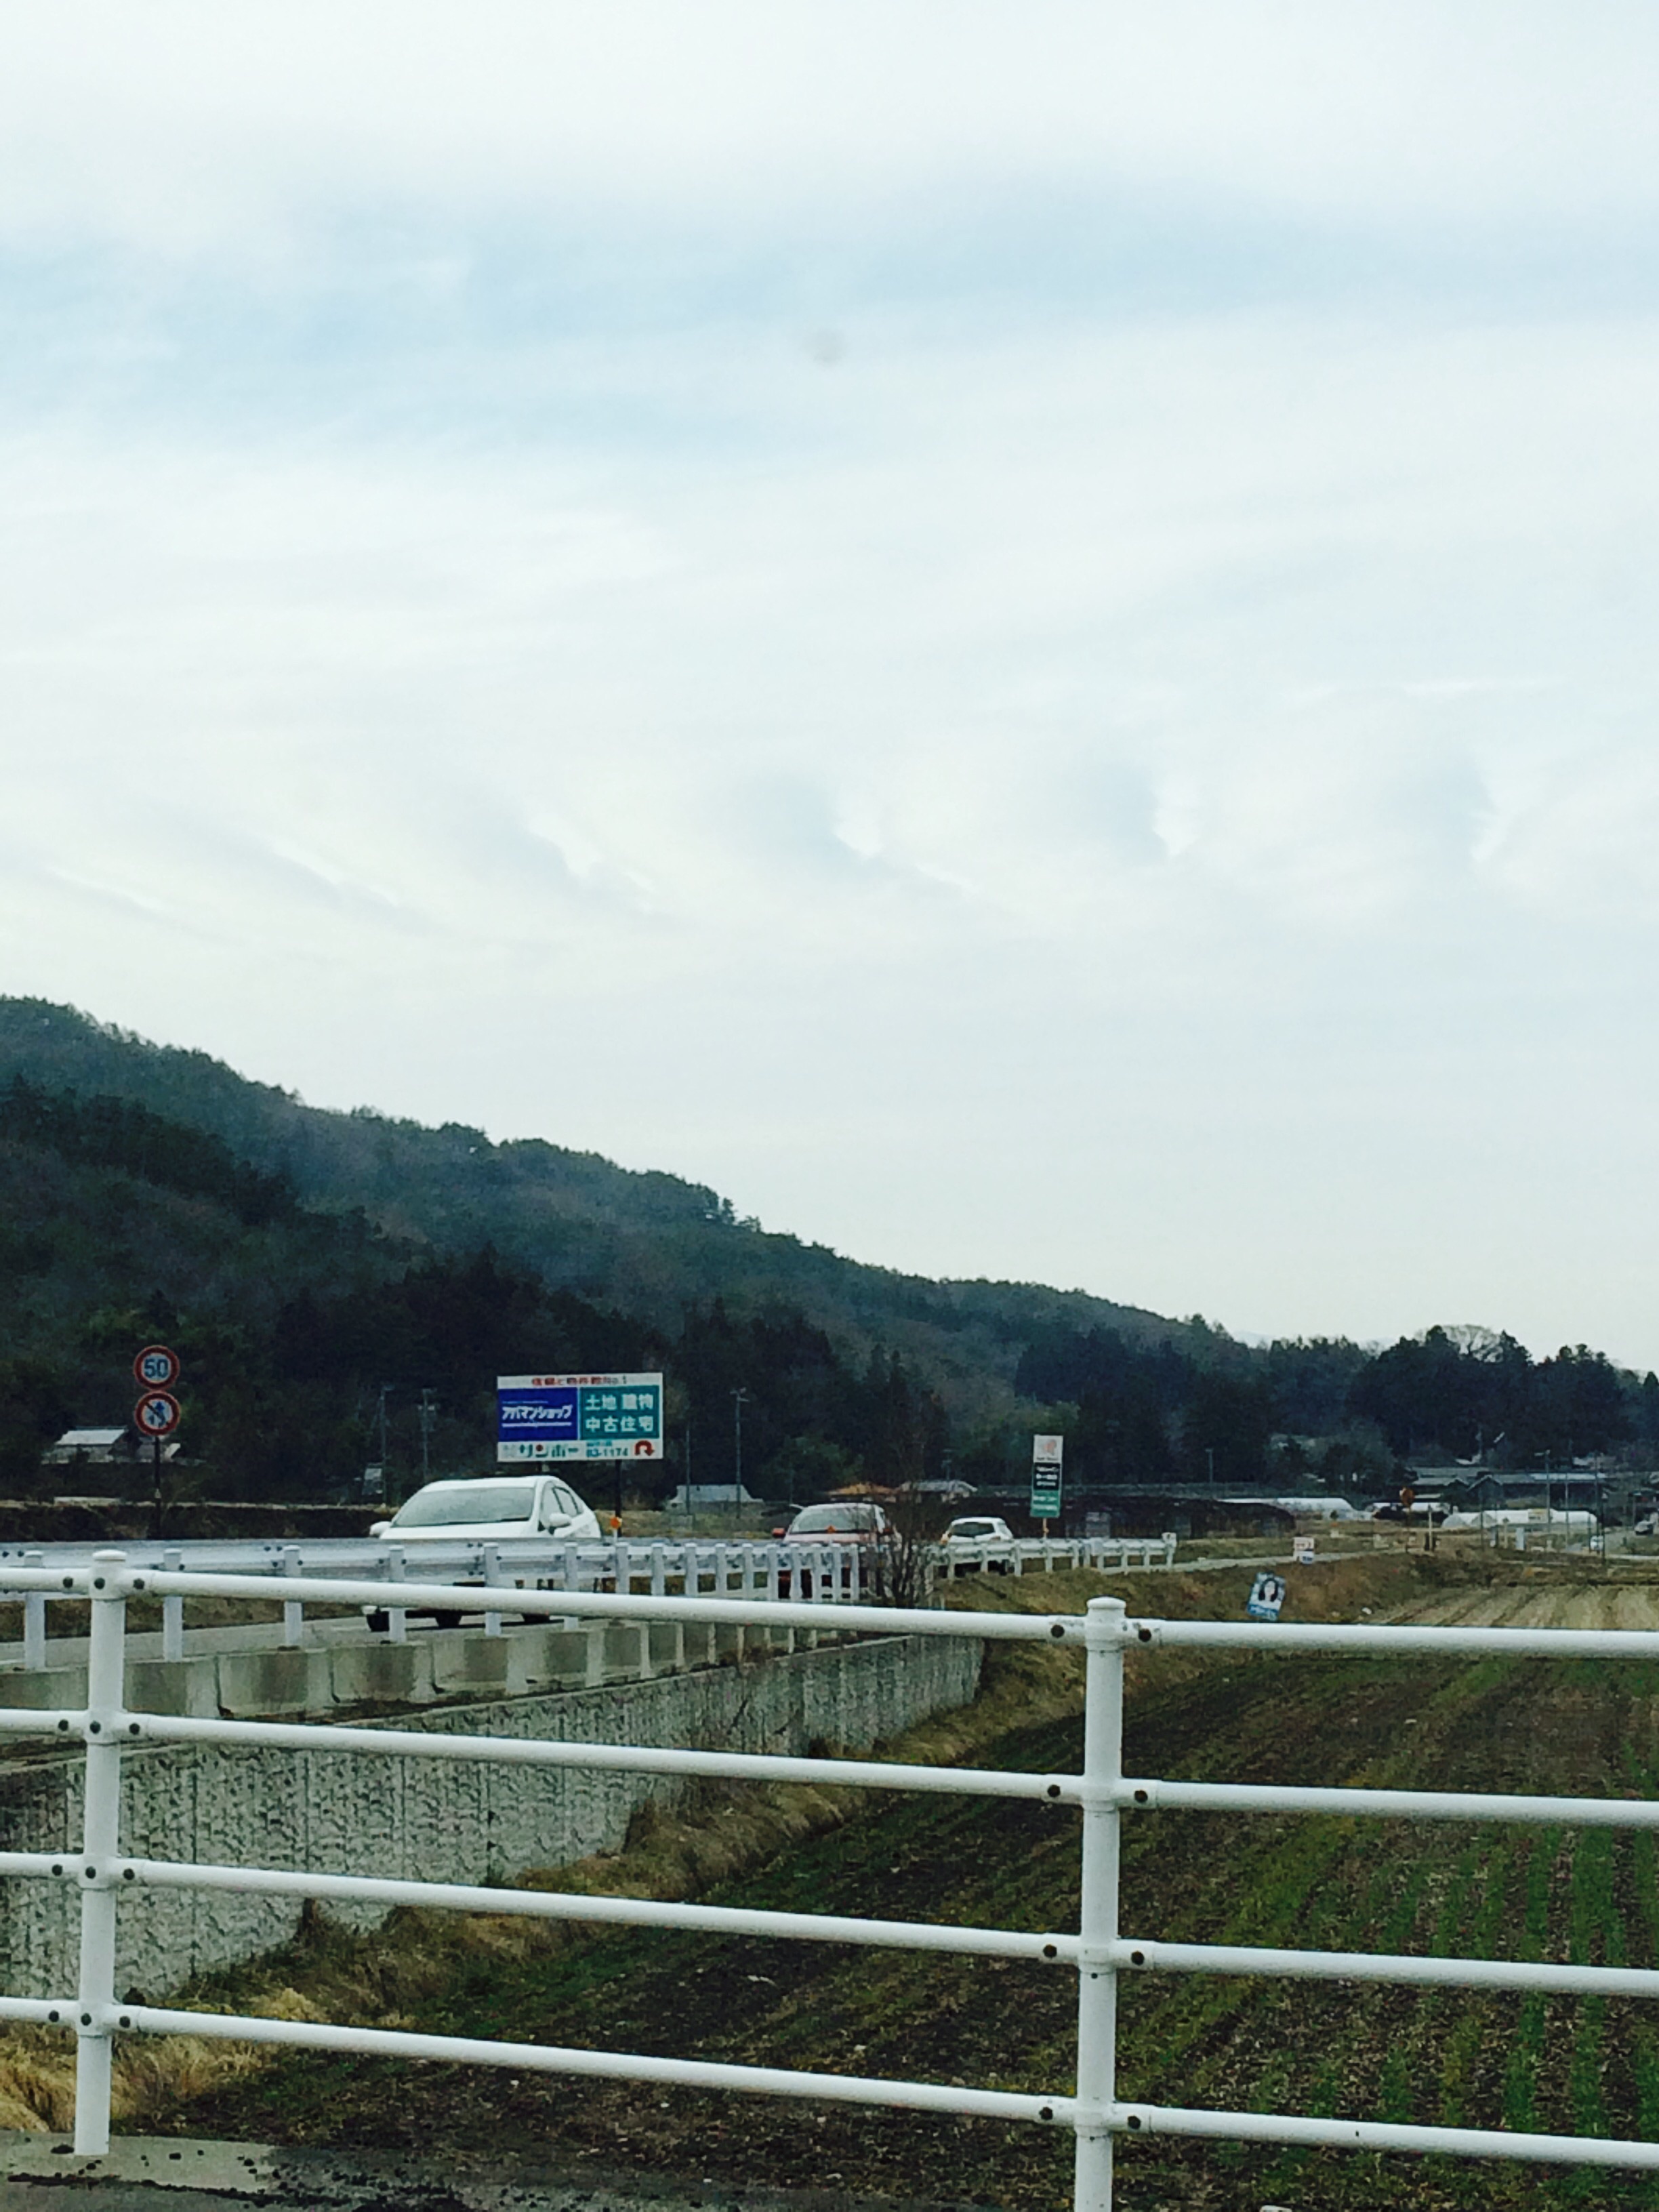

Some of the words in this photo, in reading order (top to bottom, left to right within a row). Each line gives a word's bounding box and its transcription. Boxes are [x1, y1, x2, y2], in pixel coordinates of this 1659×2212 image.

[144, 1359, 168, 1378] 50
[586, 1395, 616, 1410] 土地
[502, 1405, 573, 1420] アパマンショップ
[586, 1416, 653, 1432] 中古住宅
